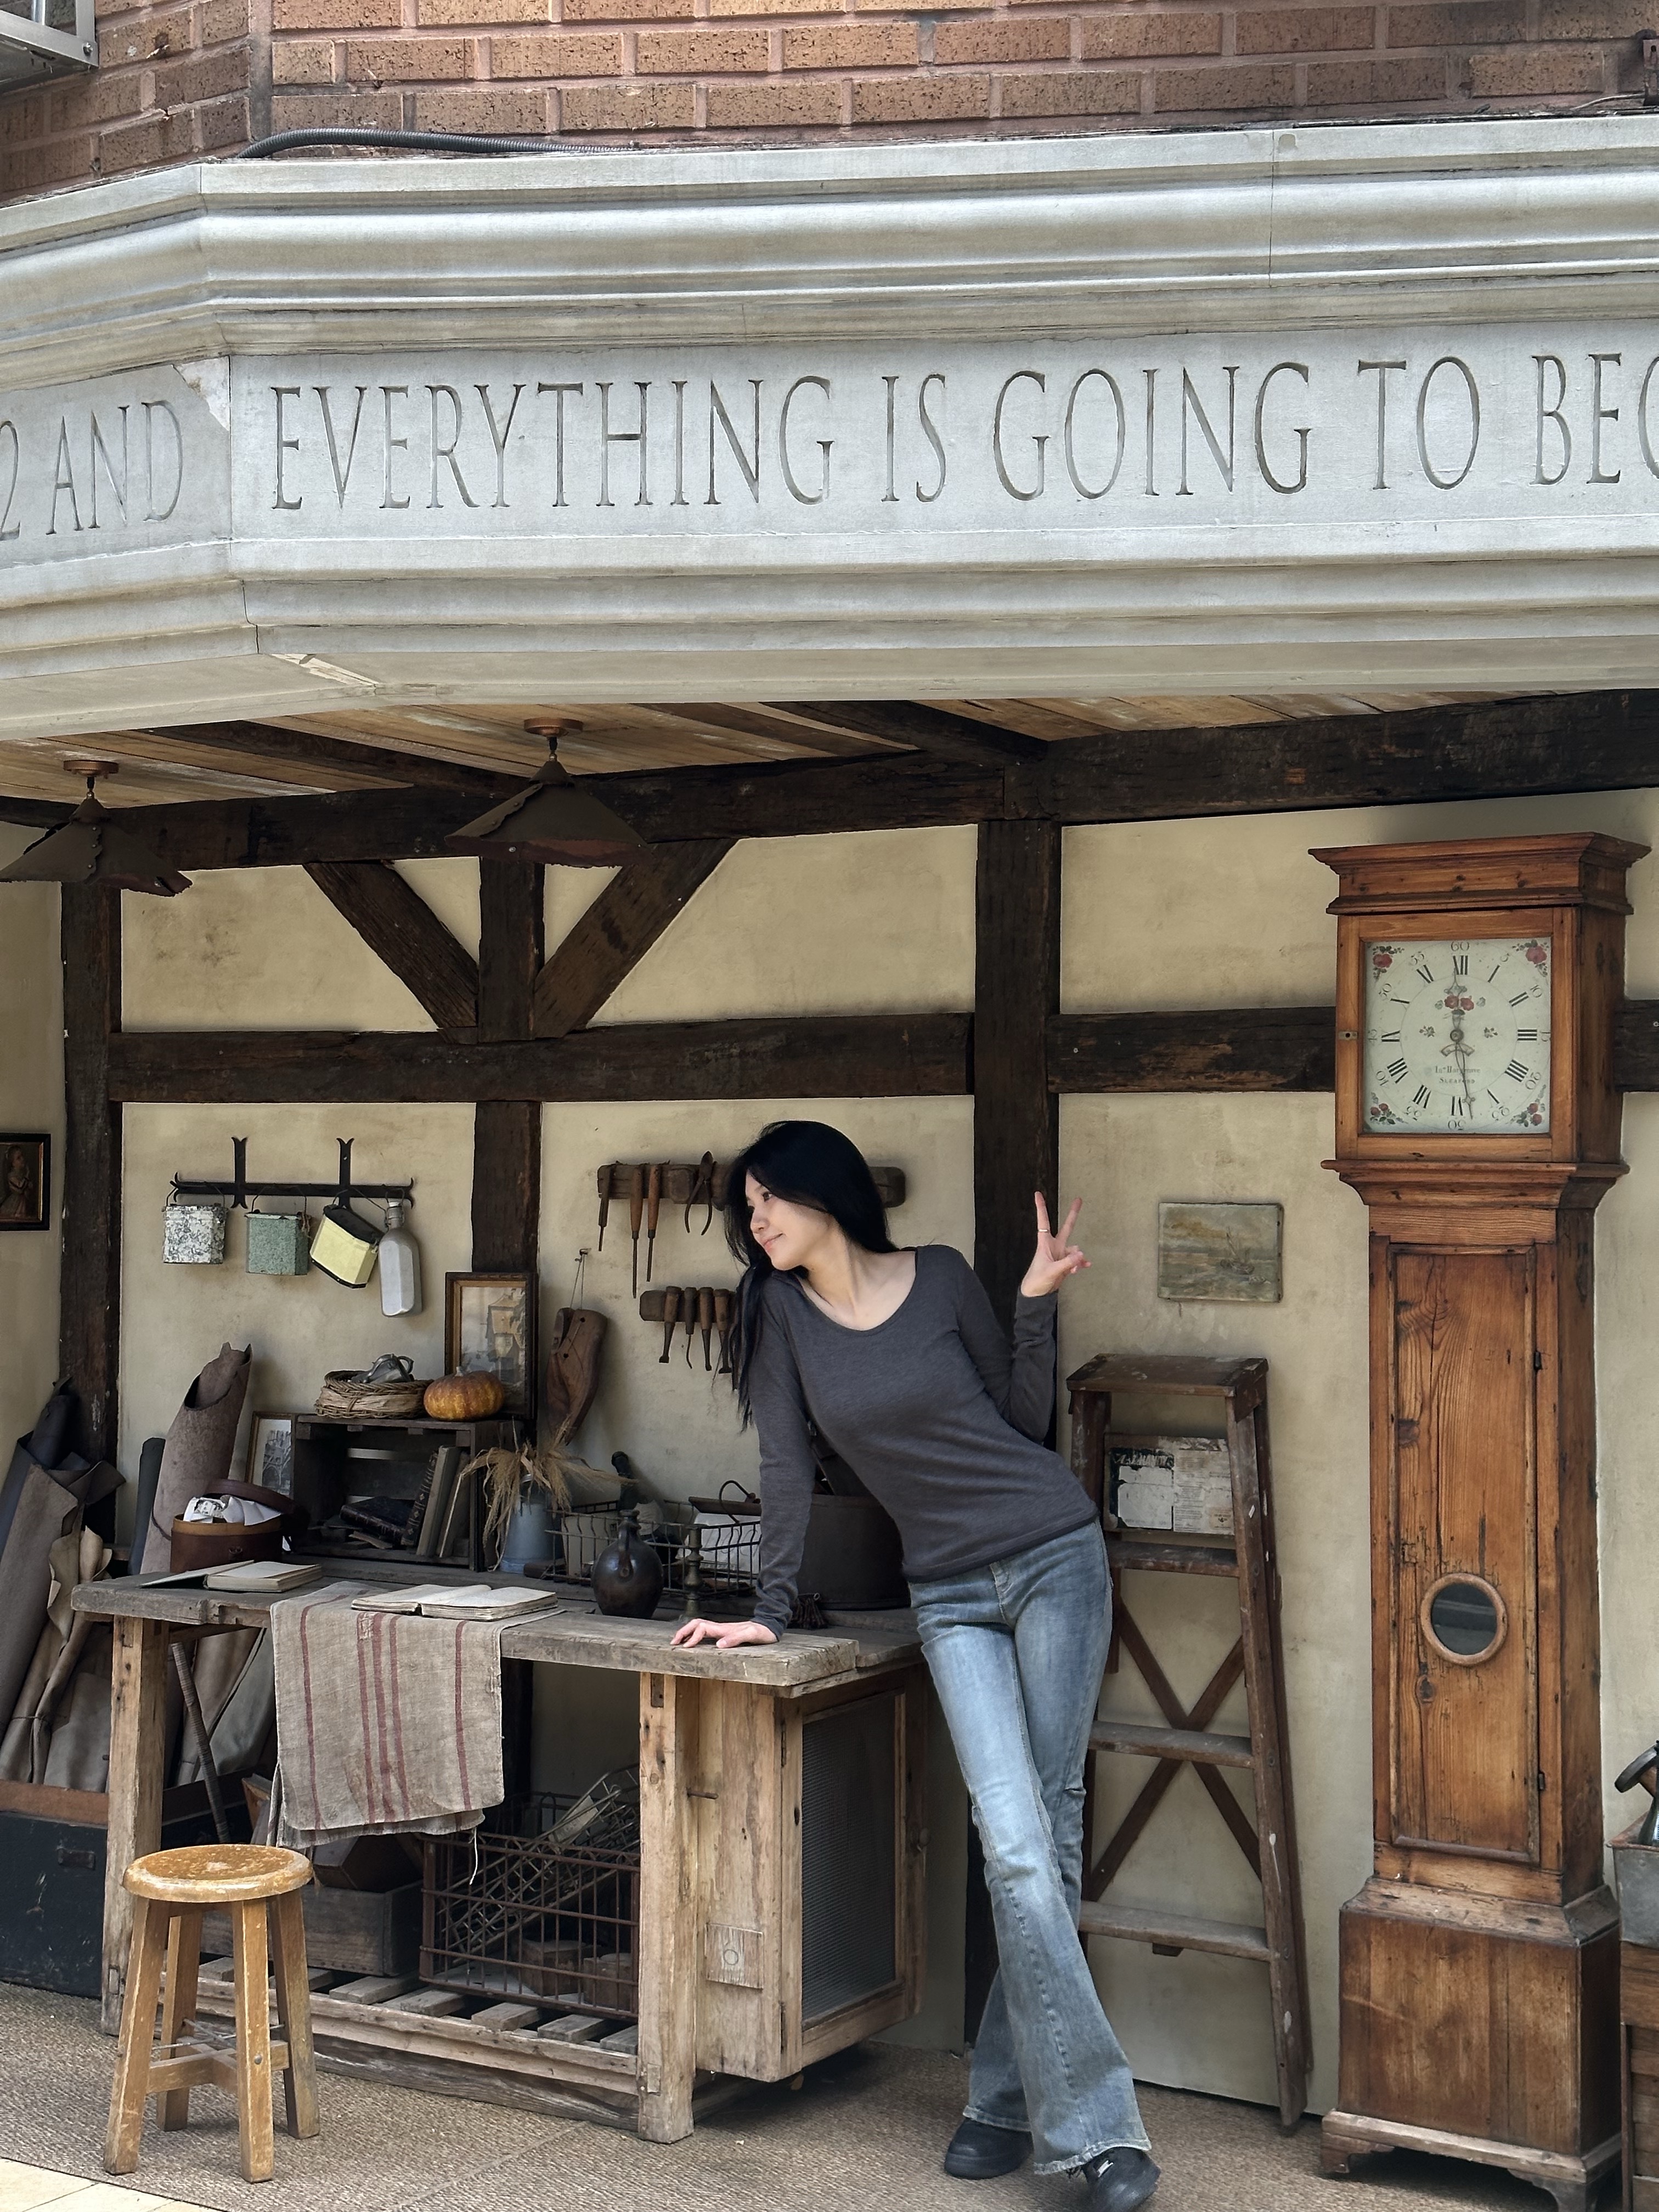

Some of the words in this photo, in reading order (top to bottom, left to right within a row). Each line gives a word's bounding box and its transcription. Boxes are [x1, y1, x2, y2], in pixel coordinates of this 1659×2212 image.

[270, 375, 834, 510] EVERYTHING
[881, 374, 946, 503] IS
[993, 361, 1312, 501] GOING
[1357, 356, 1480, 490] TO
[46, 399, 183, 535] AND
[1451, 941, 1470, 952] 60
[1530, 984, 1543, 998] 10
[1517, 1029, 1538, 1041] III
